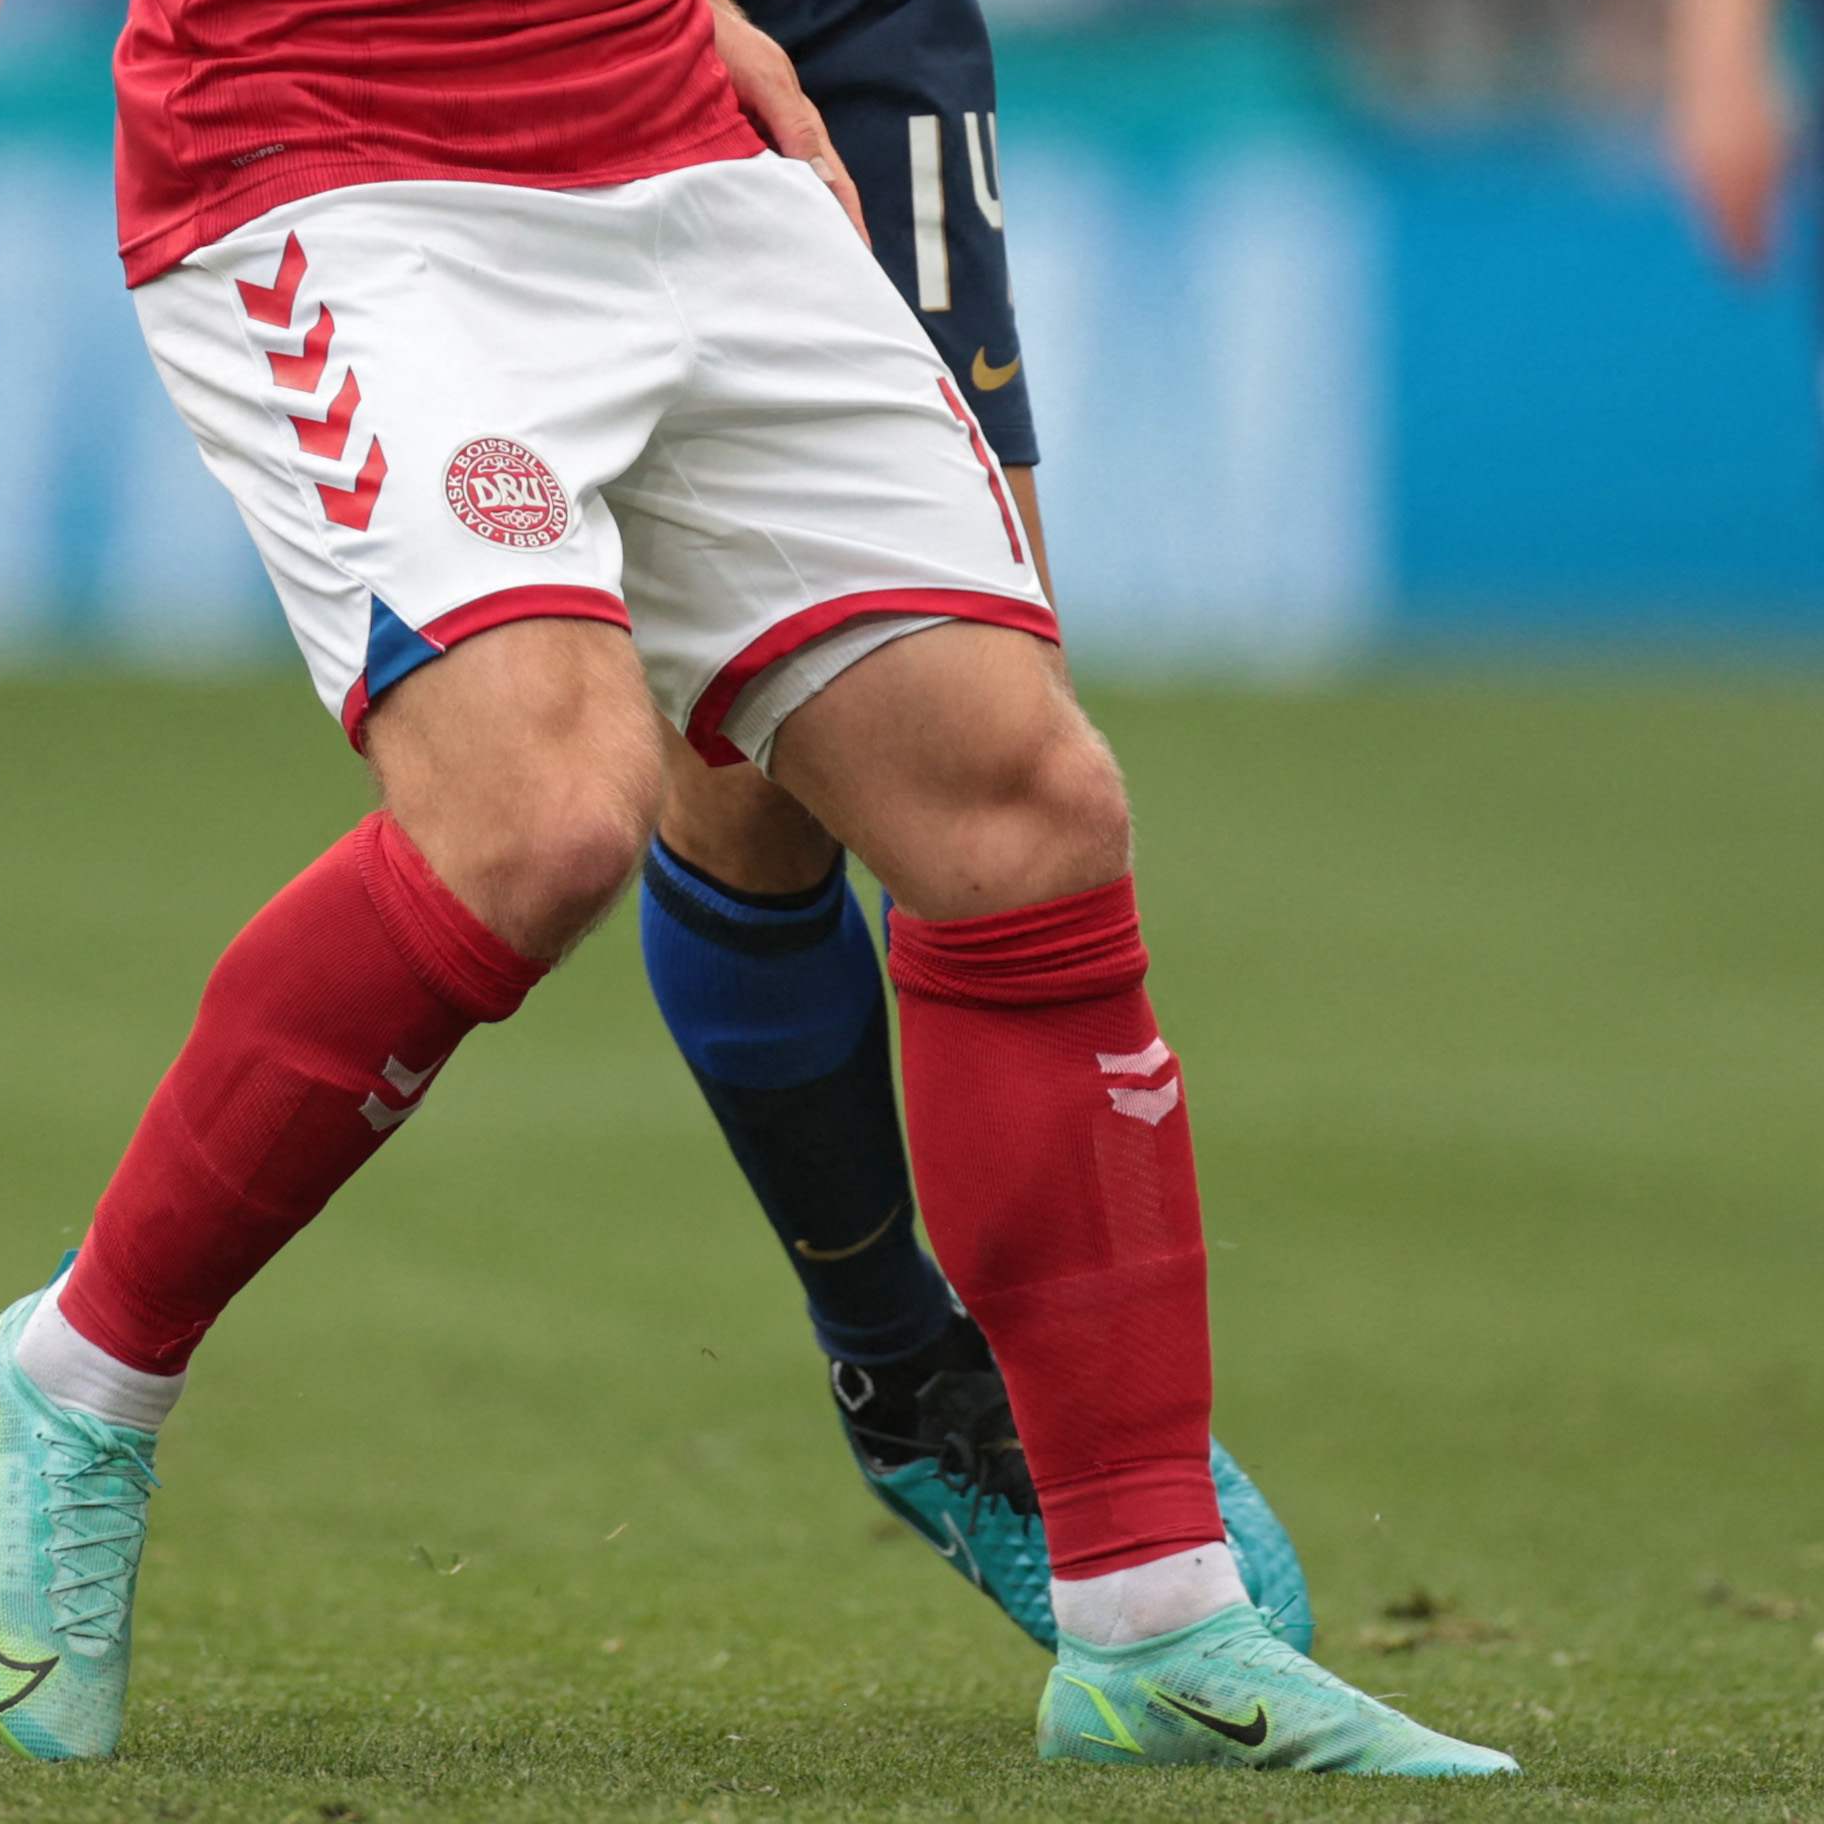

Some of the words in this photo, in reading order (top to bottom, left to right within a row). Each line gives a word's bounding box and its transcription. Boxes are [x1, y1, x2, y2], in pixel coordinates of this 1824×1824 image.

[447, 474, 494, 538] DANSK
[469, 472, 549, 509] DBU
[542, 473, 567, 535] UNION
[502, 530, 552, 547] 1889
